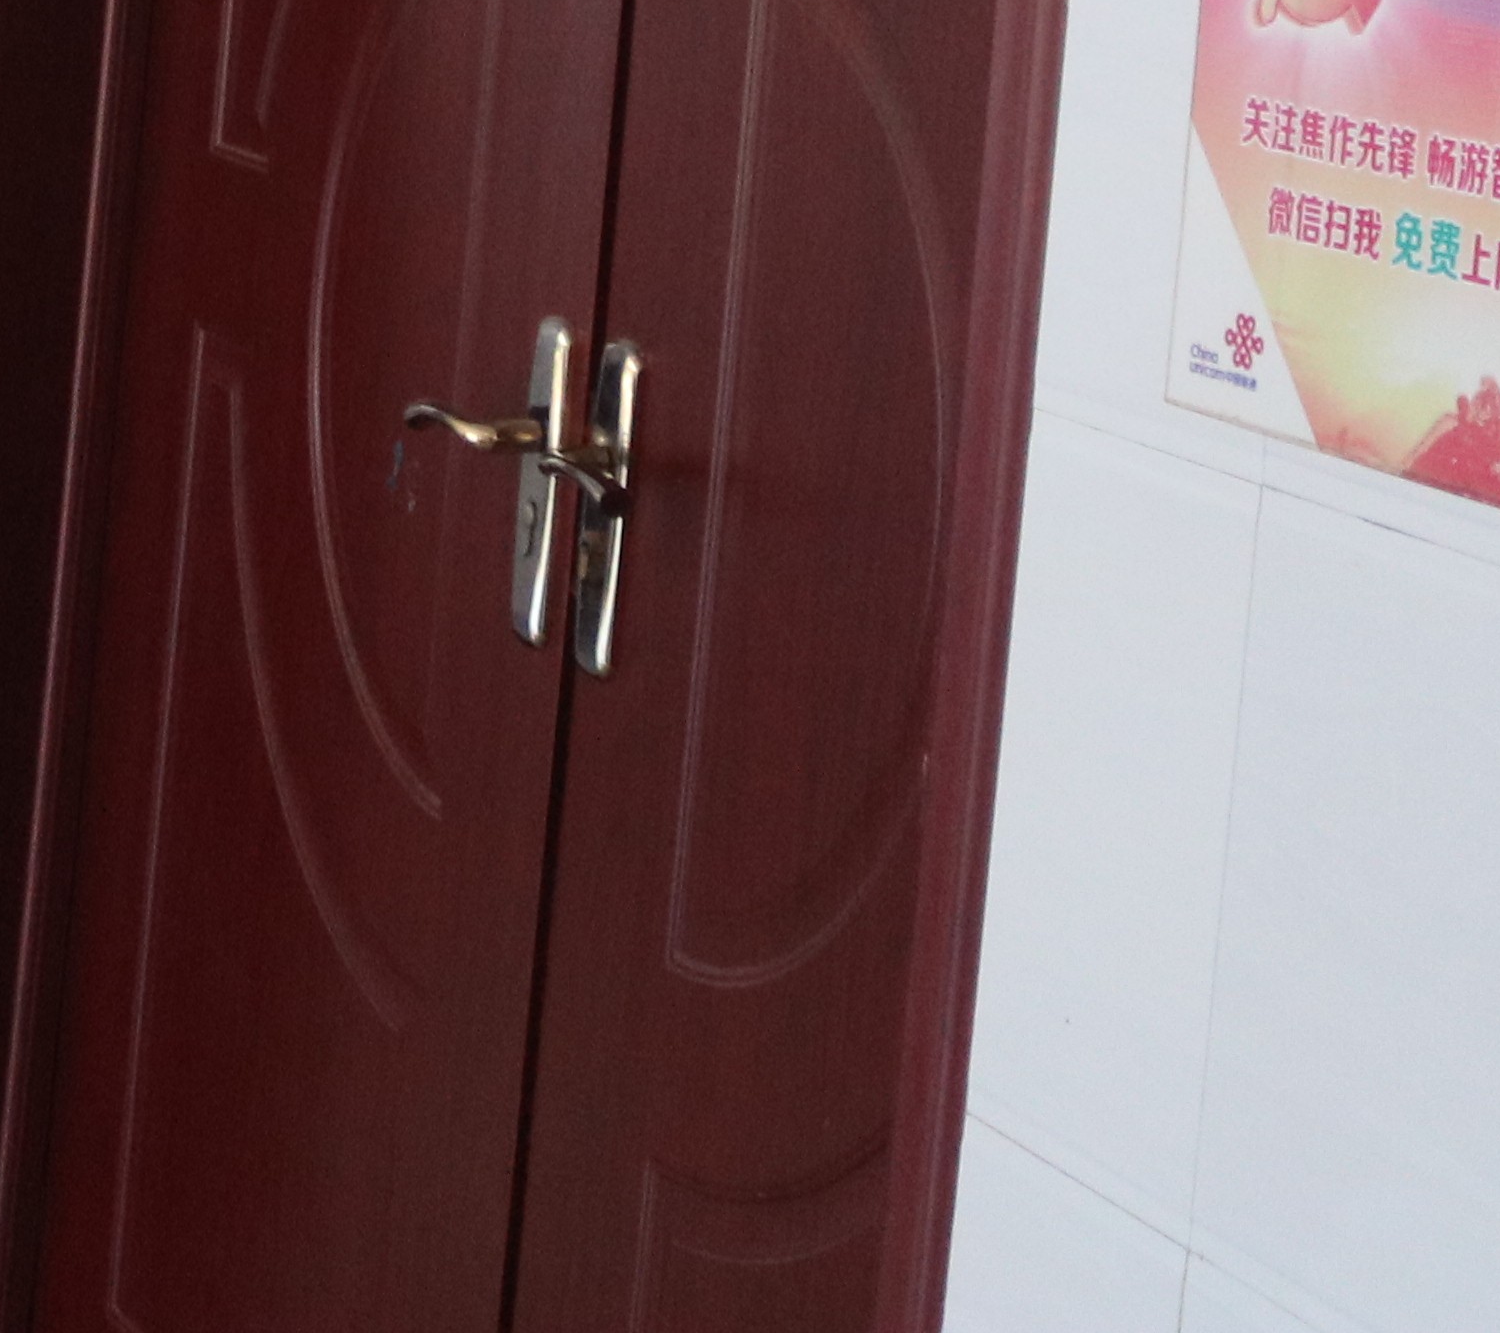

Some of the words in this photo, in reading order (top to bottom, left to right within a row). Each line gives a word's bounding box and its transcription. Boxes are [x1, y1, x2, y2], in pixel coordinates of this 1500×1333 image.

[1242, 98, 1418, 180] 关注焦作先锋
[1268, 187, 1383, 260] 微信扫我
